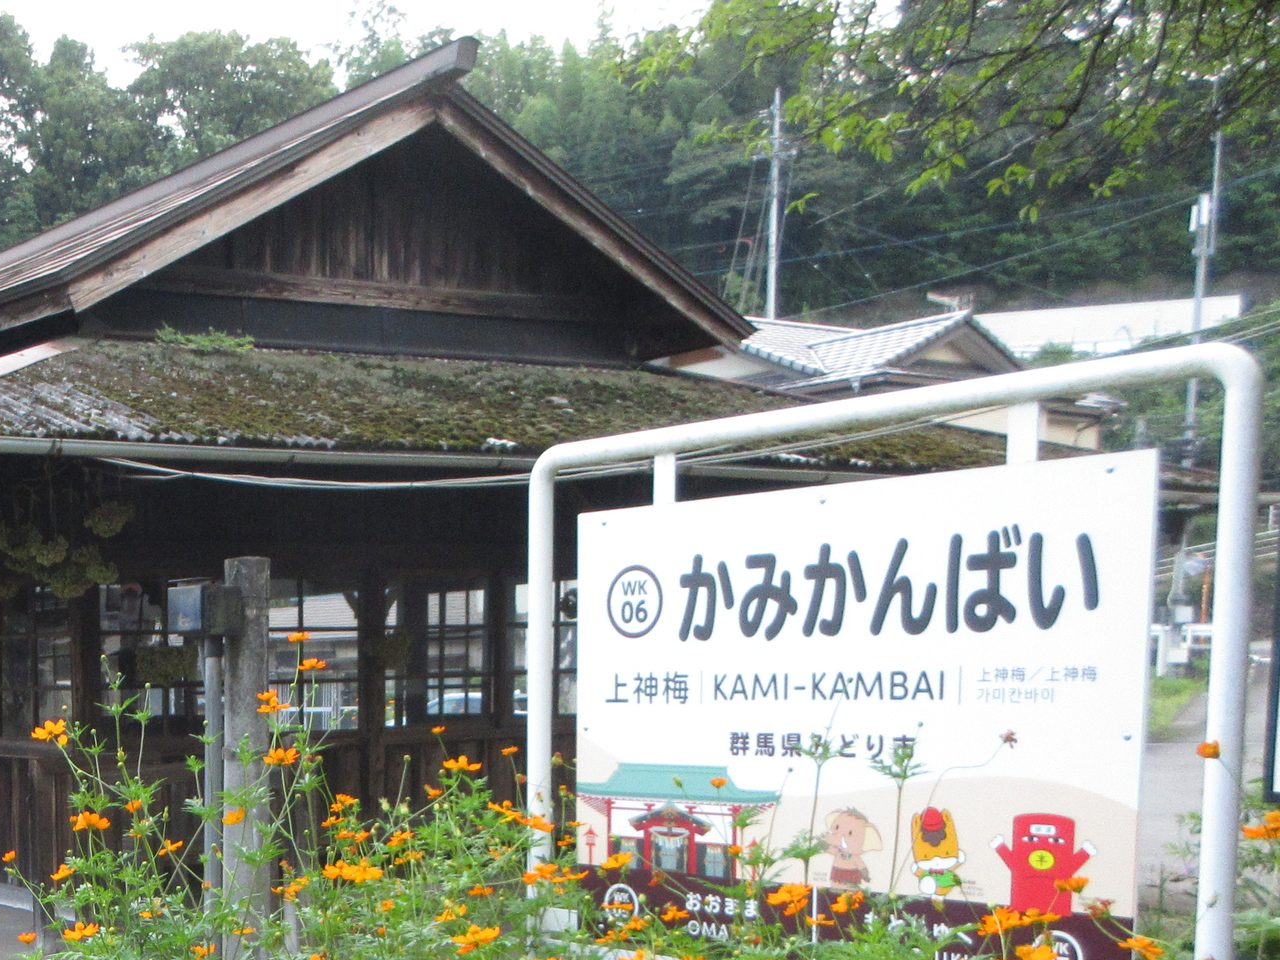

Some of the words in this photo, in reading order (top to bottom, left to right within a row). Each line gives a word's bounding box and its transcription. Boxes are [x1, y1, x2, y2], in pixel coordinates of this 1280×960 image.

[620, 580, 648, 597] WK
[679, 523, 1100, 642] かみかんばい
[620, 601, 649, 625] 06
[606, 672, 689, 705] 上神梅
[714, 671, 944, 701] KAMI-KAMBAI
